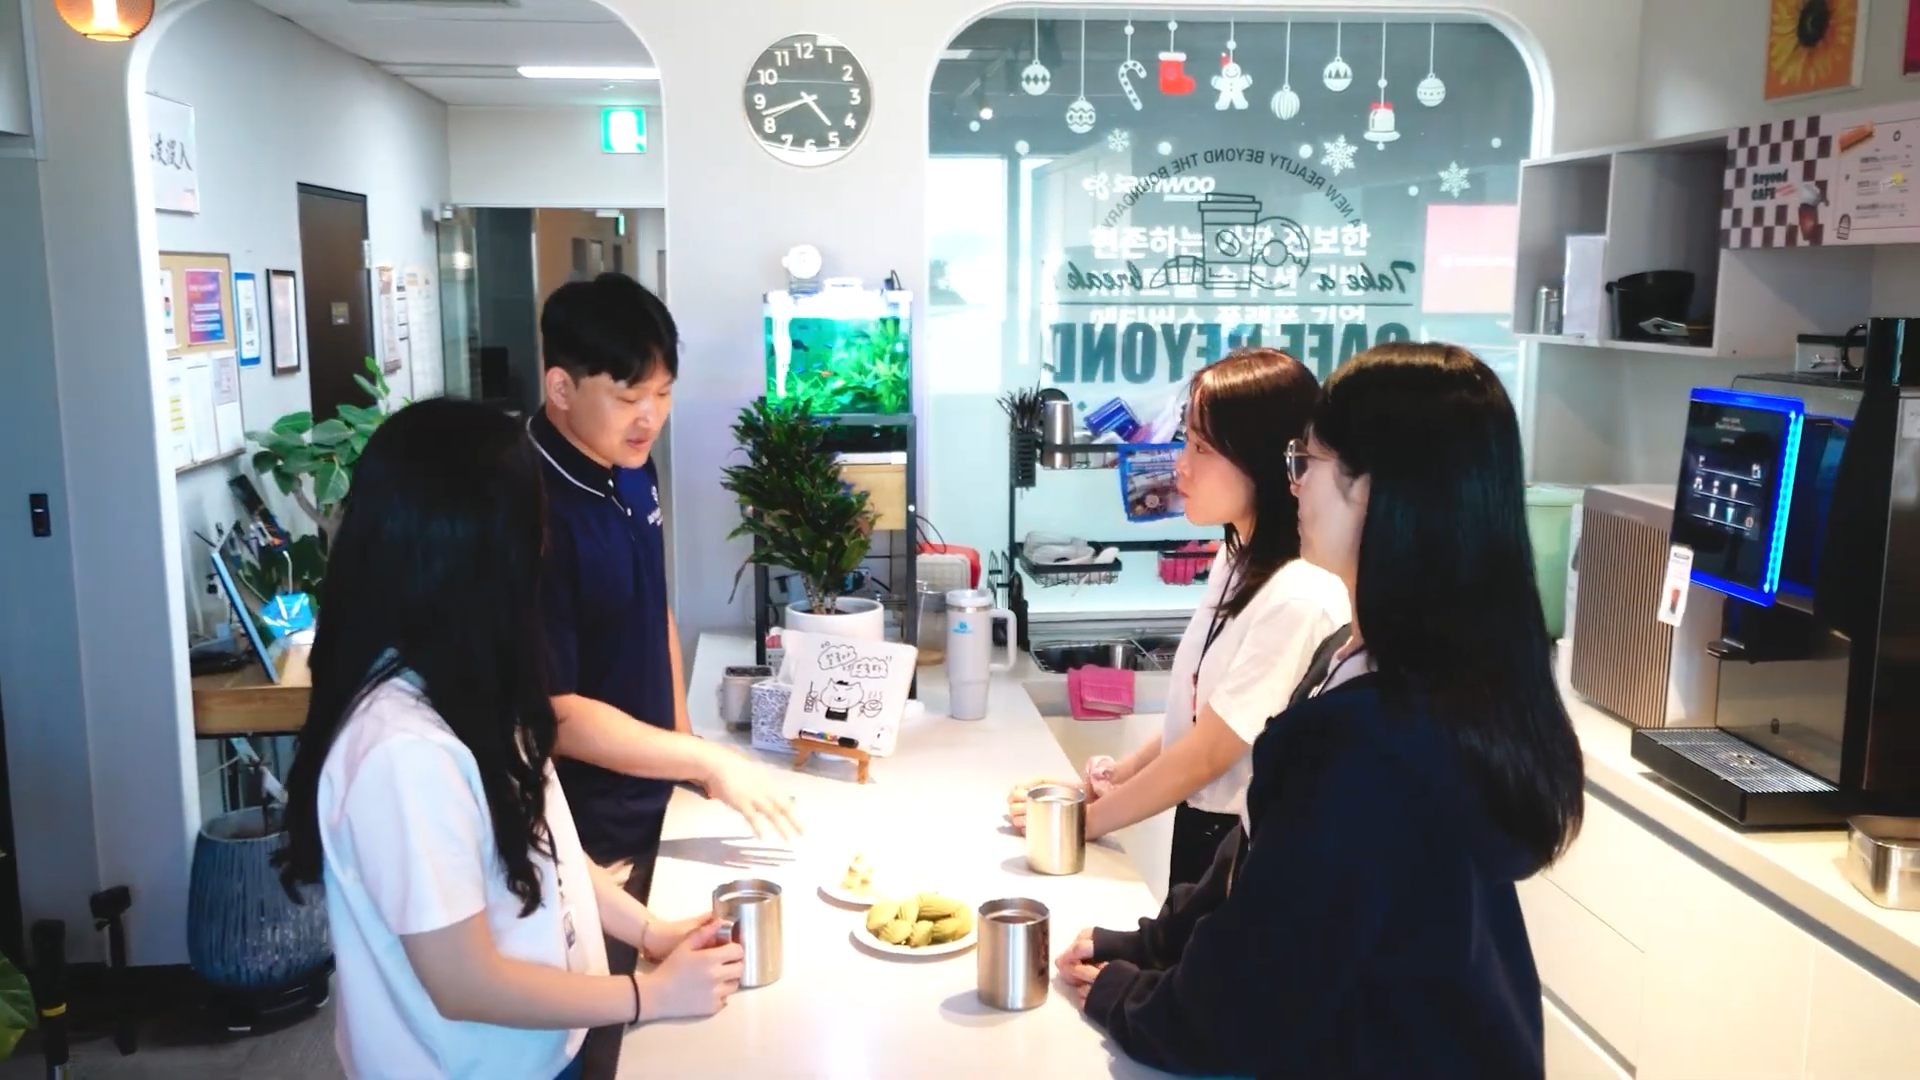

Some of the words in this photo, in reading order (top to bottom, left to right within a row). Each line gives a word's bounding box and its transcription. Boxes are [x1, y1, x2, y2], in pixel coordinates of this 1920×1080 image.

[774, 50, 790, 66] 11
[794, 42, 814, 59] 12
[824, 48, 833, 64] 1
[756, 68, 778, 85] 10
[842, 65, 854, 82] 2
[754, 94, 766, 110] 9
[849, 88, 862, 105] 3
[764, 116, 776, 134] 8
[844, 113, 856, 130] 4
[780, 134, 794, 150] 7
[804, 138, 817, 153] 6
[828, 132, 840, 149] 5
[1752, 169, 1788, 187] Beyond
